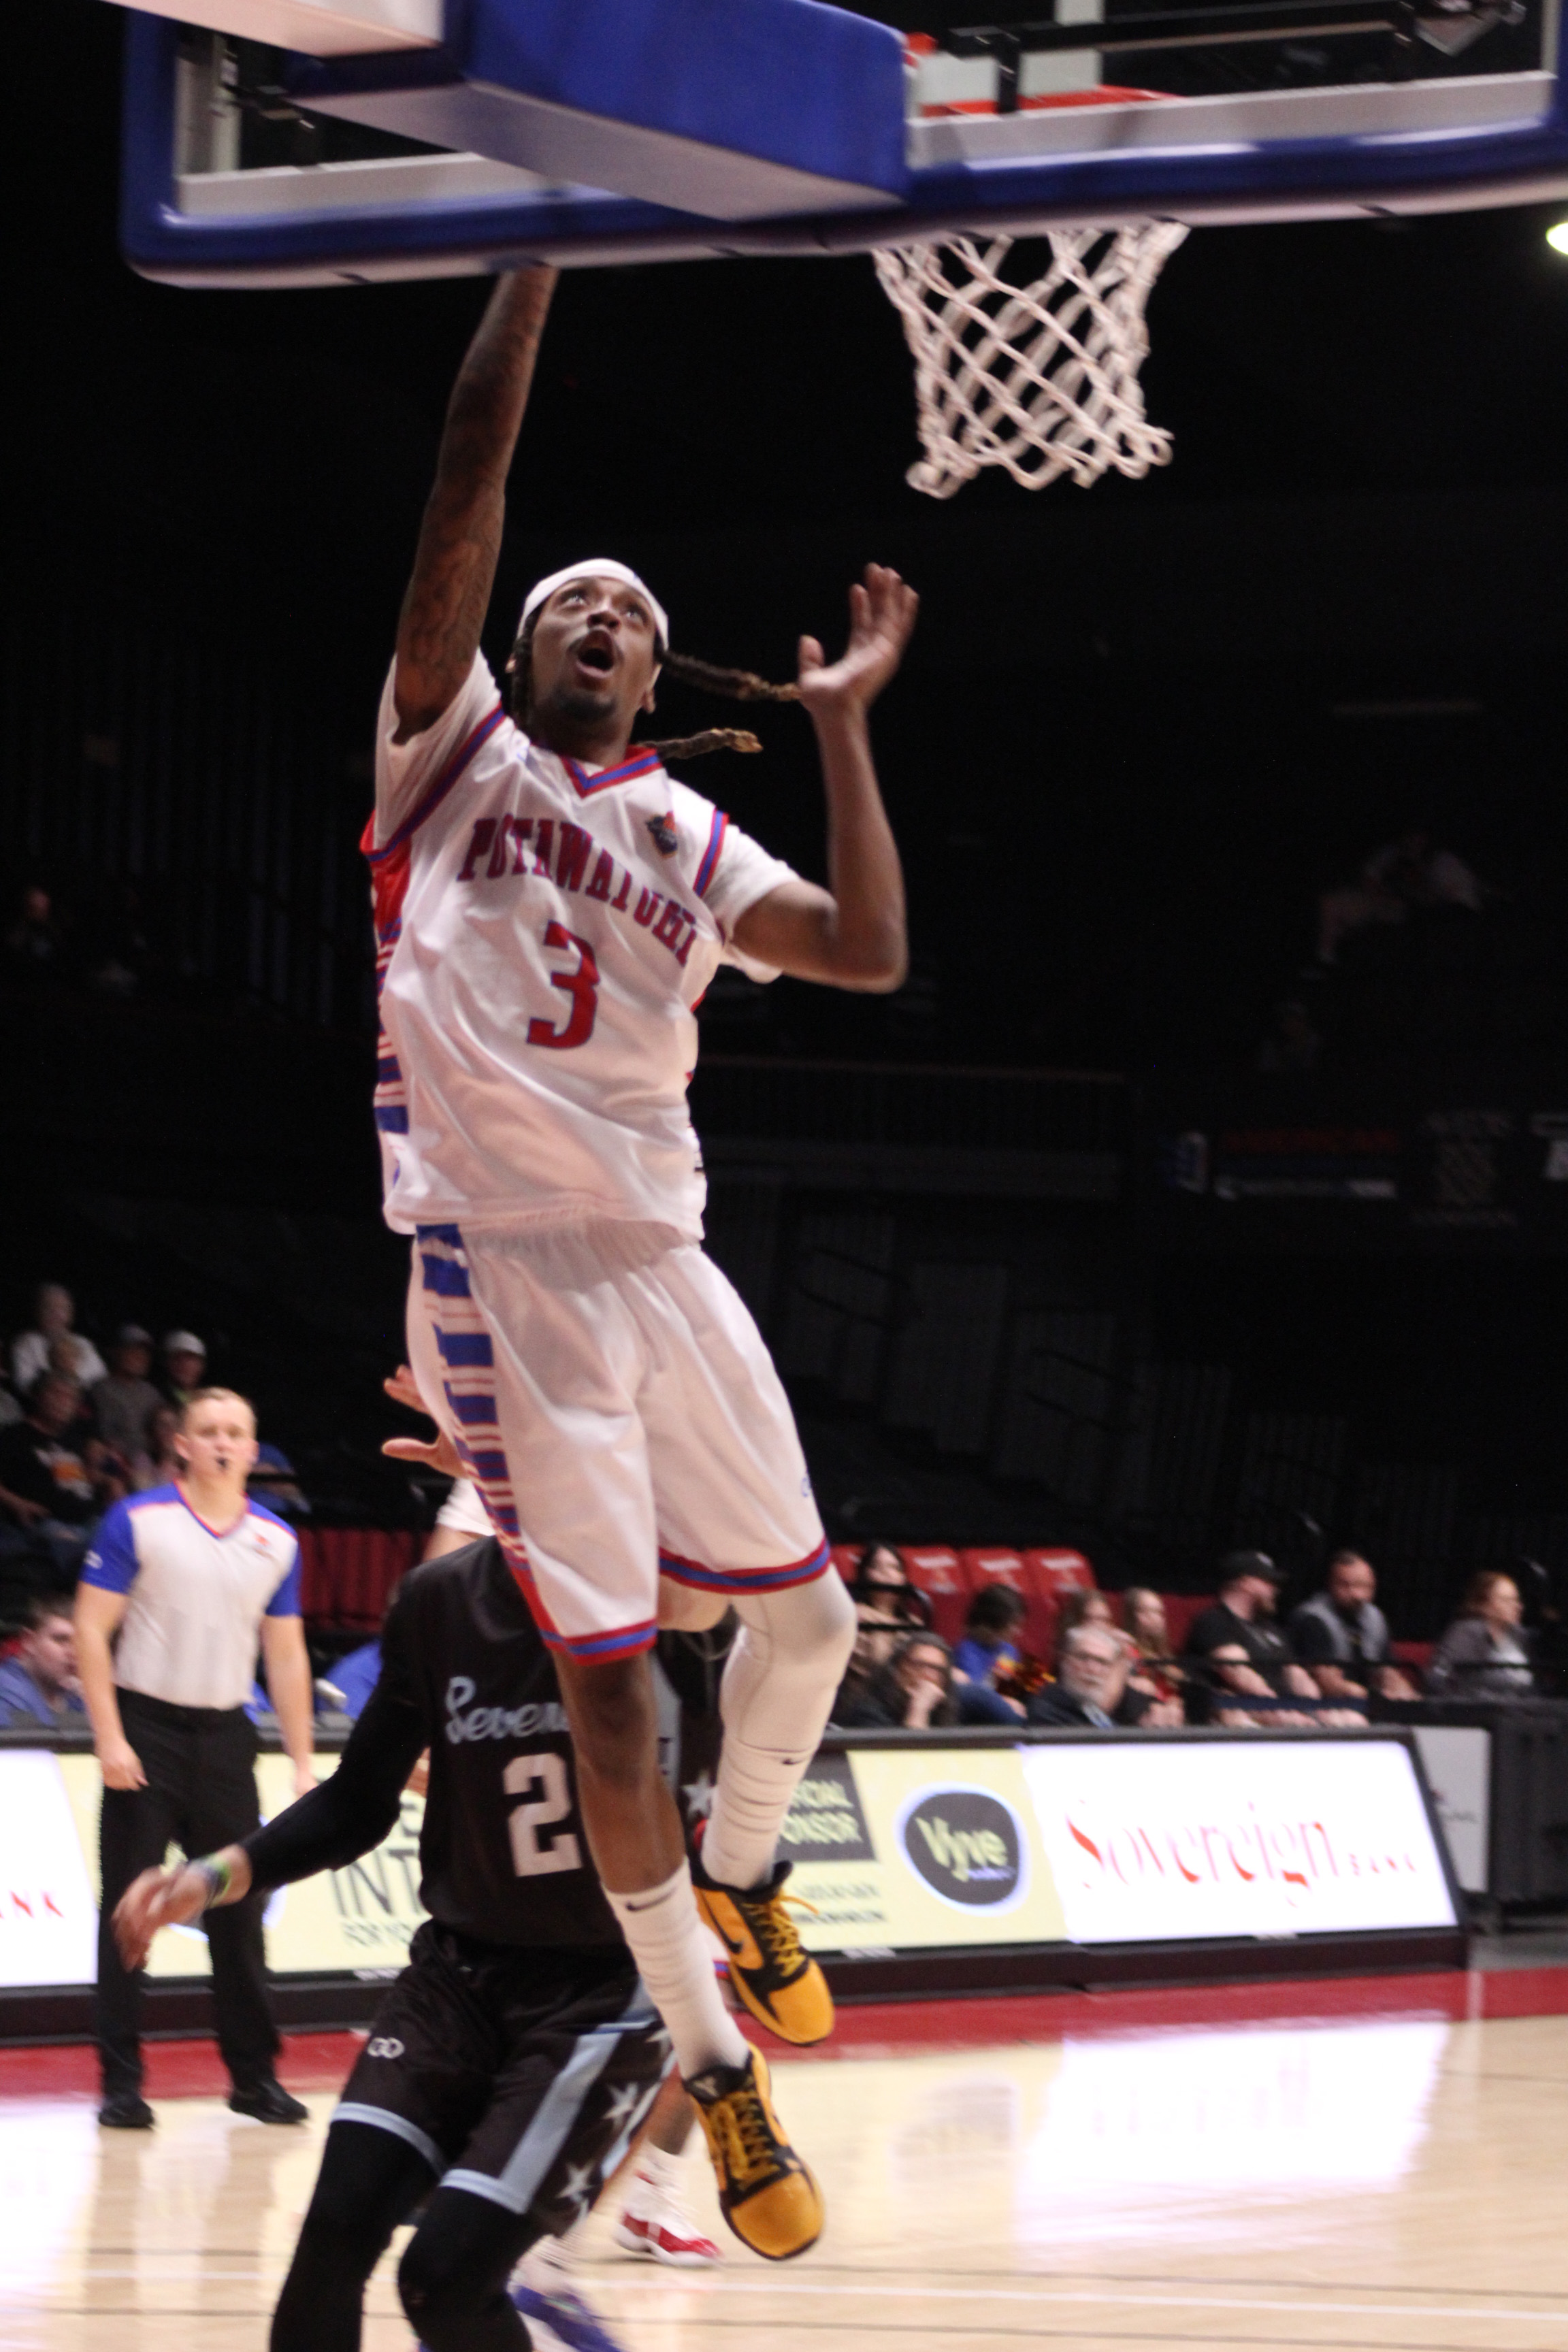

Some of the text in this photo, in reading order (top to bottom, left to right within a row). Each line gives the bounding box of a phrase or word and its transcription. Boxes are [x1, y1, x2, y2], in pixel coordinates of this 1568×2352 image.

[526, 919, 600, 1049] 3
[502, 1752, 583, 1877] 2
[780, 1810, 864, 1845] ONSOR
[1065, 1799, 1338, 1908] Sovereign
